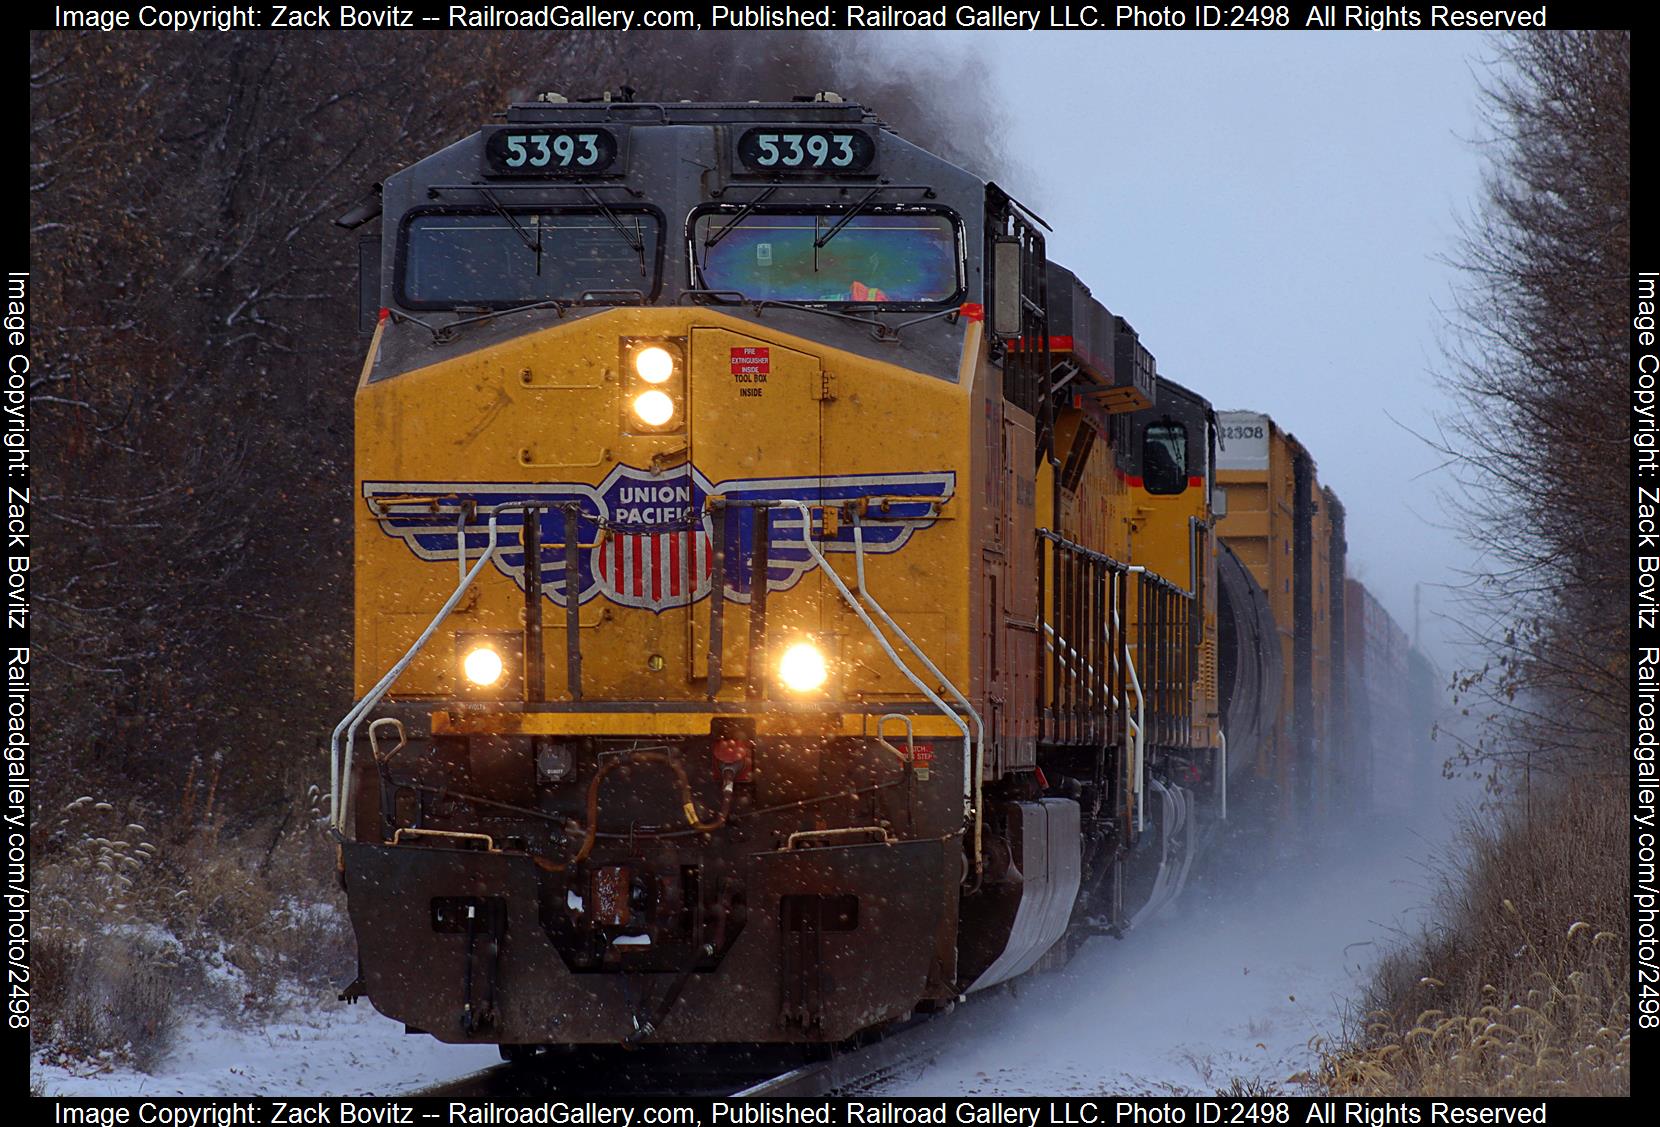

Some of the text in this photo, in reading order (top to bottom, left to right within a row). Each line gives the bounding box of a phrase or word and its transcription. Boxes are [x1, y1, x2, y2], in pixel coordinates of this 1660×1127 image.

[506, 135, 598, 167] 5393
[757, 135, 854, 167] 5393
[735, 374, 767, 383] TOOL BOX
[740, 388, 762, 397] INSIDE
[620, 486, 691, 504] UNION
